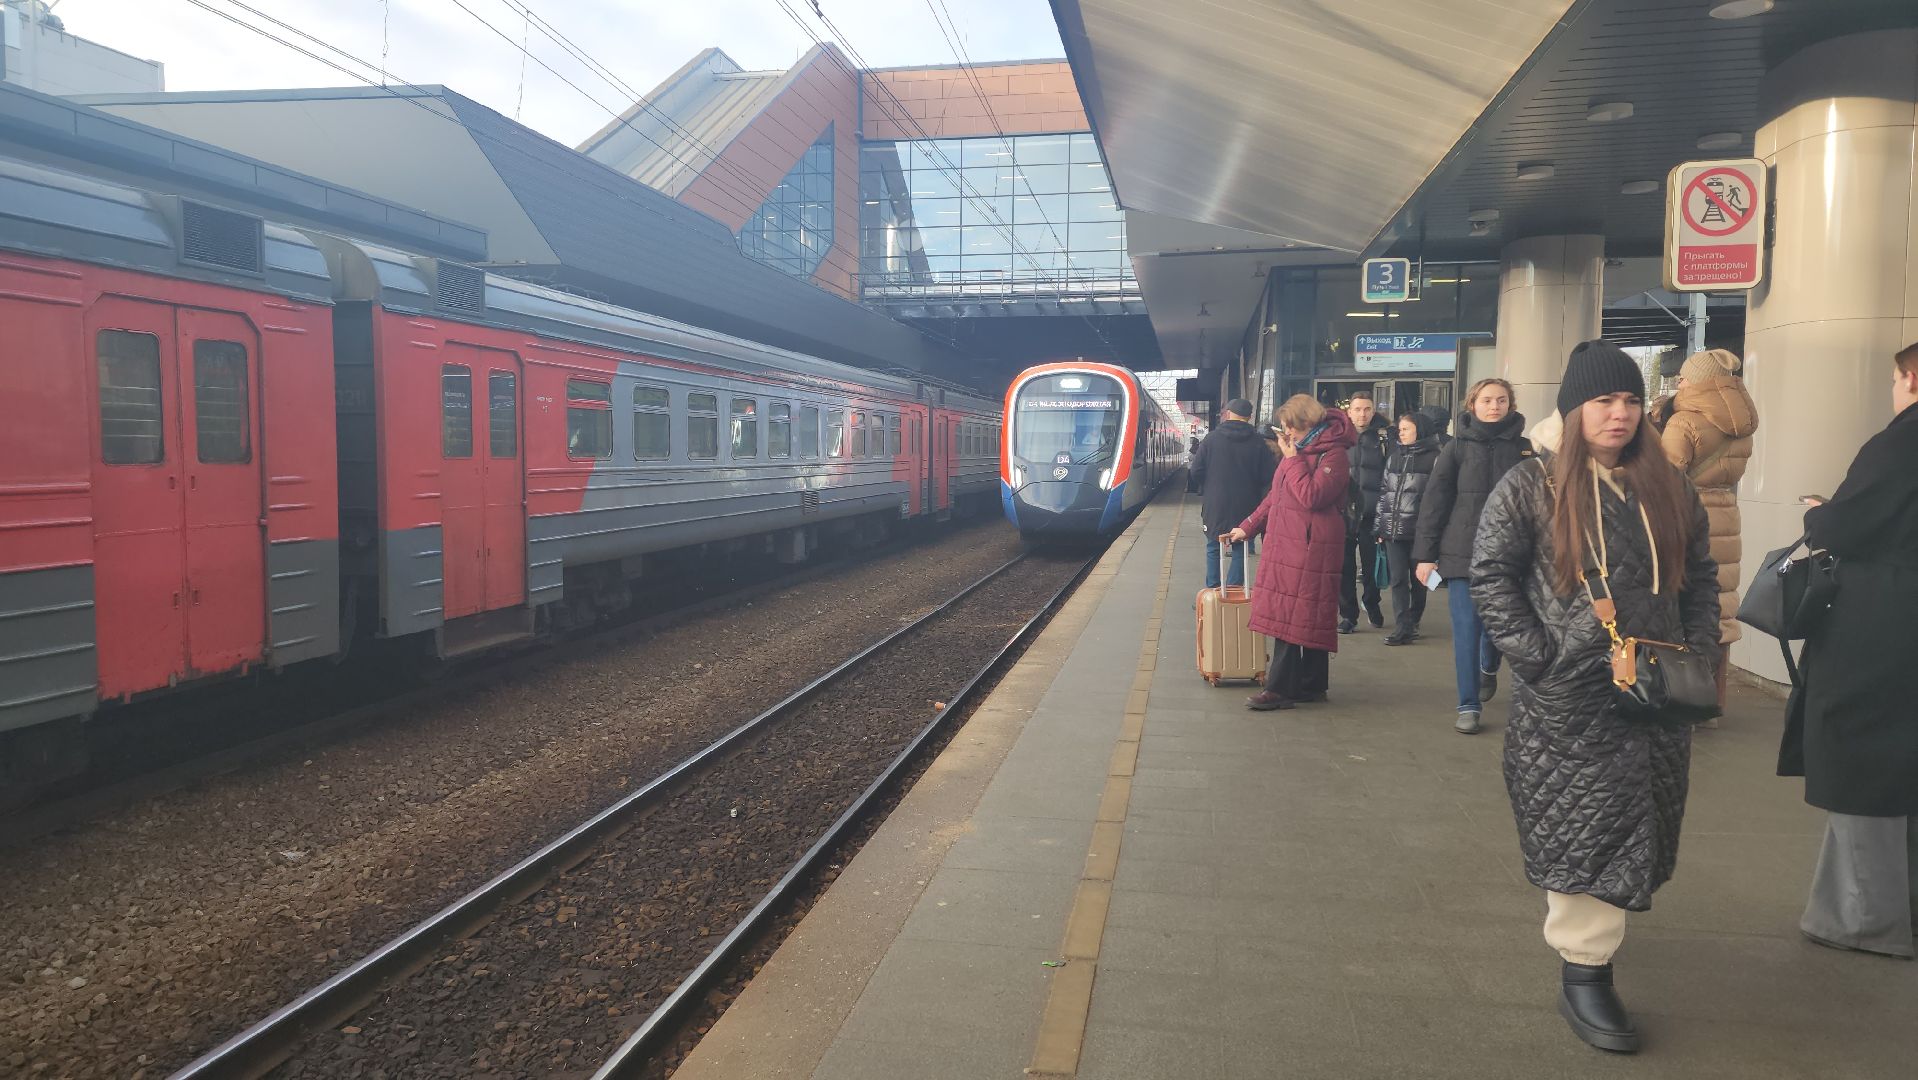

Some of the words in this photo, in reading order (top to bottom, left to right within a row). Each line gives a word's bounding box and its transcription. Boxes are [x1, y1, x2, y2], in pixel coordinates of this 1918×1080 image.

[1684, 252, 1725, 261] Прыгать
[1691, 262, 1748, 271] платформы
[1380, 263, 1393, 284] 3
[1684, 271, 1742, 281] запрещено!
[1366, 336, 1392, 344] Выход
